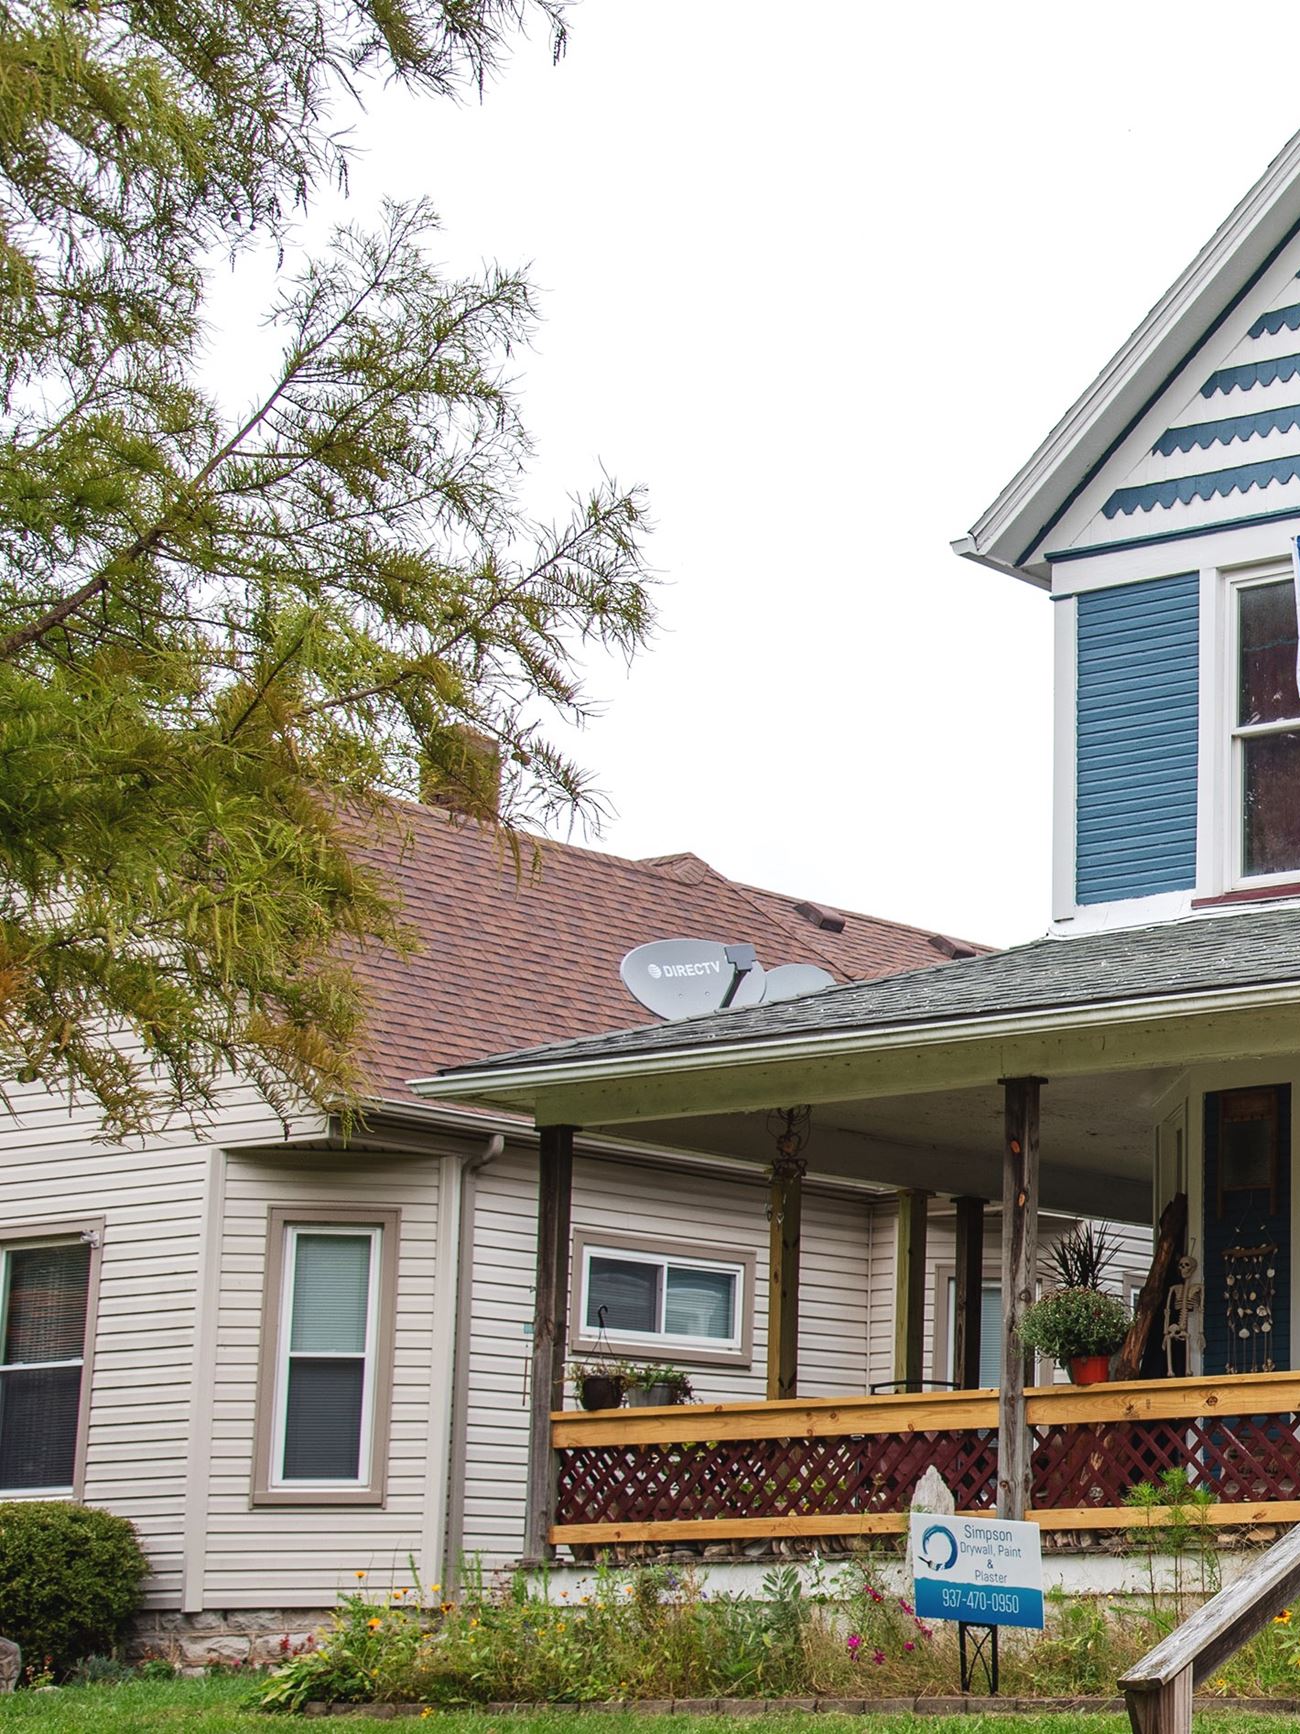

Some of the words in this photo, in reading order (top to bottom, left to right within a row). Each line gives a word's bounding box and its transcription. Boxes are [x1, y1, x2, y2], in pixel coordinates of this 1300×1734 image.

[663, 960, 720, 977] DIRECTV
[964, 1524, 1013, 1543] Simpson
[960, 1541, 996, 1557] Drywall,
[998, 1544, 1022, 1558] Paint
[987, 1558, 994, 1569] &
[975, 1569, 1008, 1583] Plaster
[942, 1588, 1020, 1614] 937-470-0950
